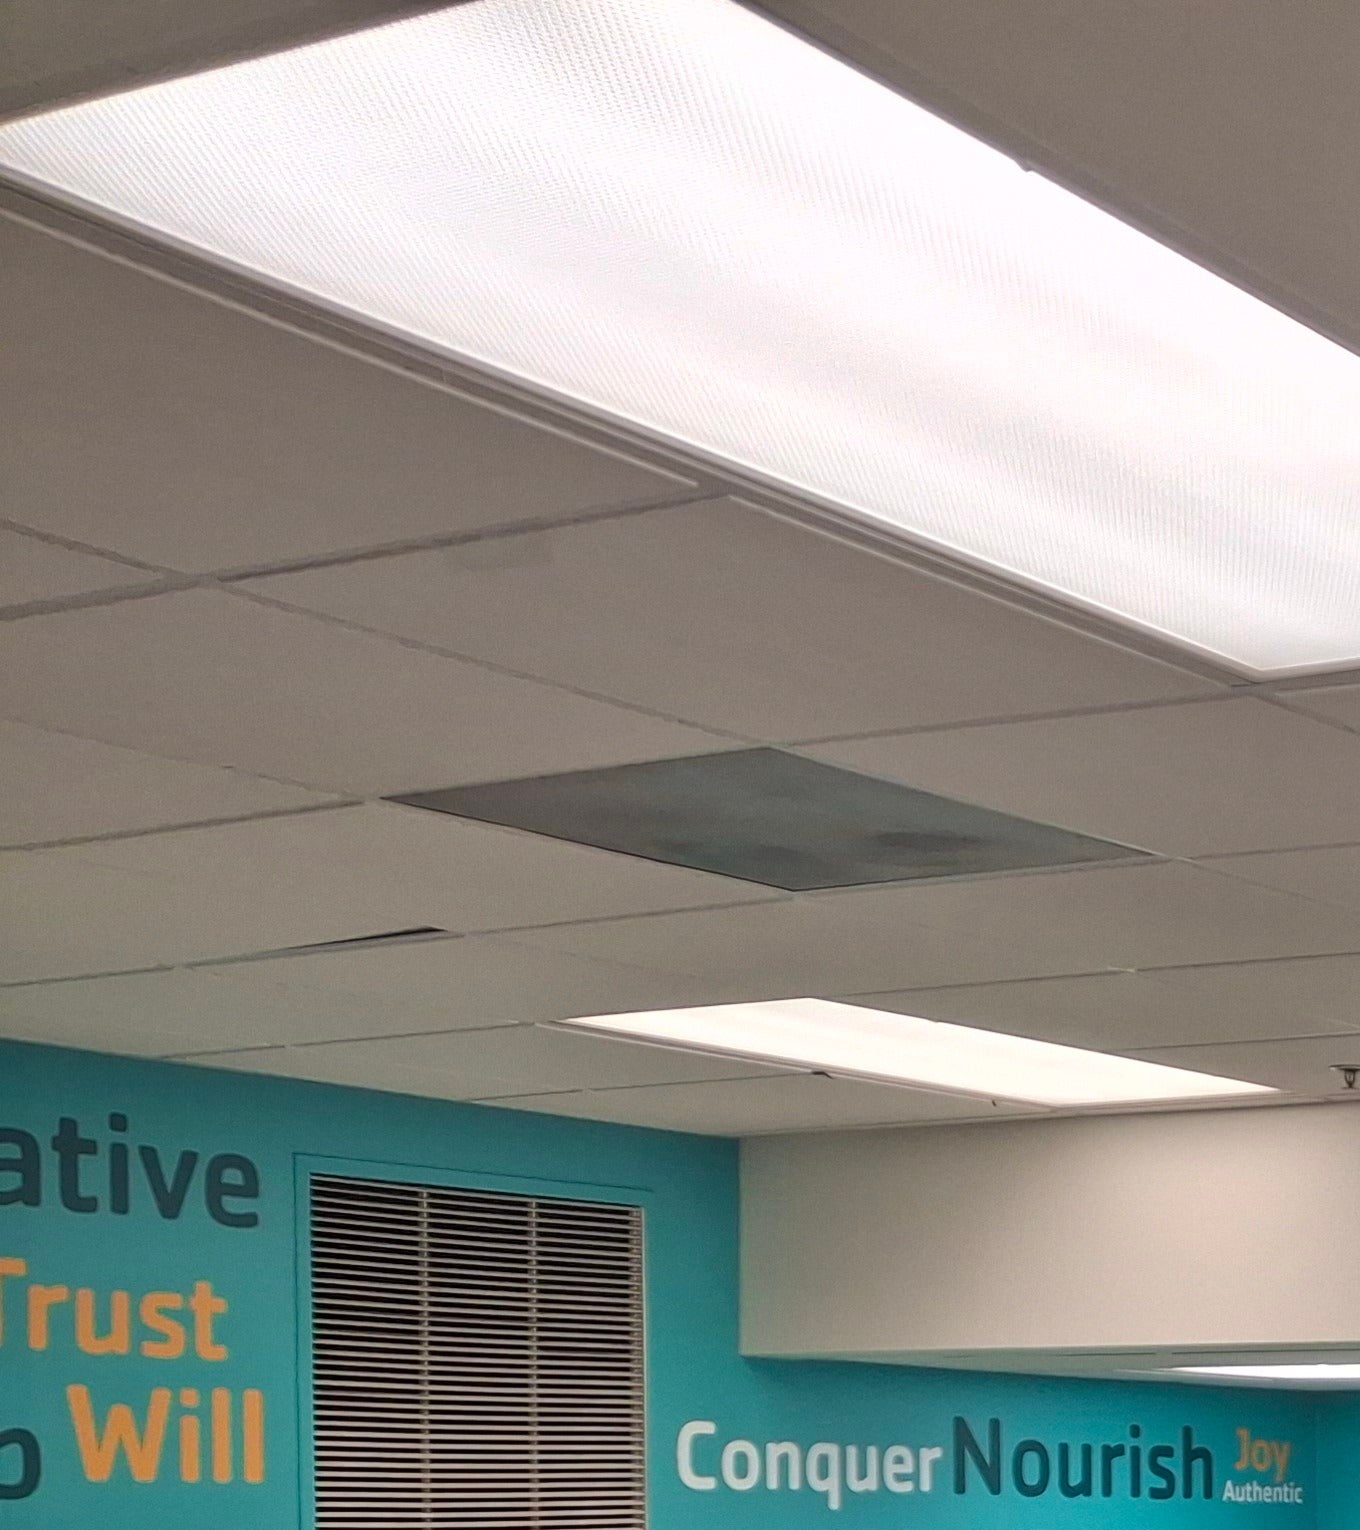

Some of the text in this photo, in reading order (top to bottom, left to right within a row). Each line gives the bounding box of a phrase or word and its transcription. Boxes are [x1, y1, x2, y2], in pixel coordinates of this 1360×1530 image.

[0, 1112, 259, 1228] ative
[67, 1384, 265, 1483] Will
[677, 1416, 1291, 1510] Conquer Nourish Joy
[1222, 1478, 1303, 1504] Authentic
